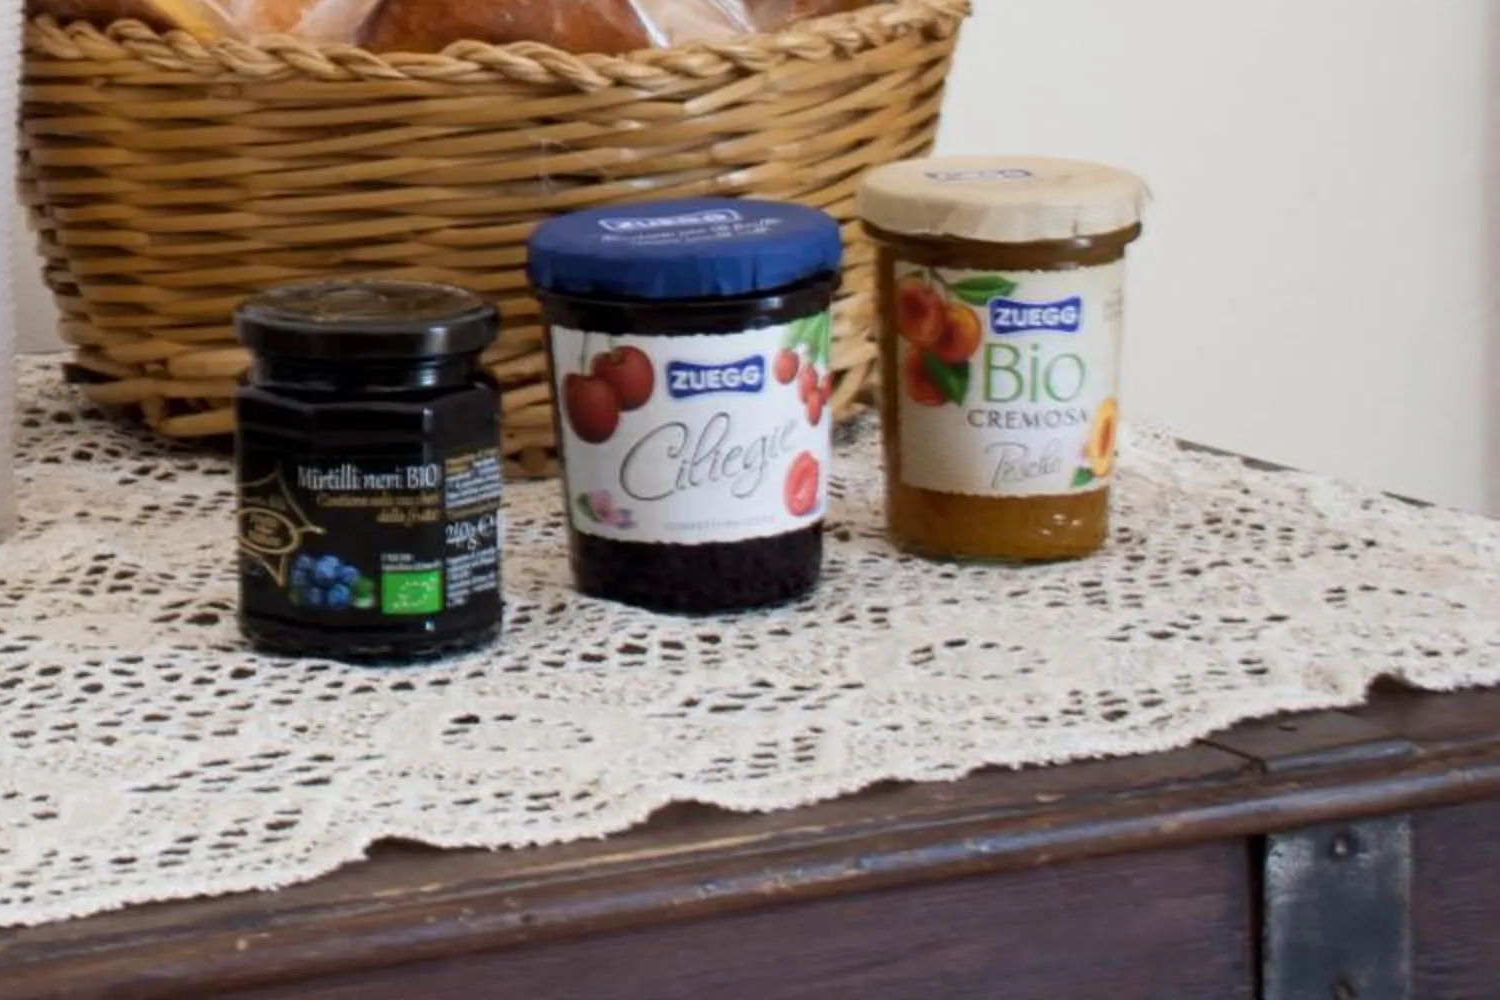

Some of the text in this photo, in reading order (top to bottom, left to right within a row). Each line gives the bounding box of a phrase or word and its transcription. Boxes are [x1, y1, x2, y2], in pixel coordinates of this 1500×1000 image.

[995, 305, 1077, 327] ZUEGG
[671, 365, 760, 391] ZUEGG
[983, 342, 1087, 404] Bio
[966, 407, 1088, 431] CREMOSA
[619, 411, 799, 501] Ciliegie
[406, 462, 439, 489] BIO
